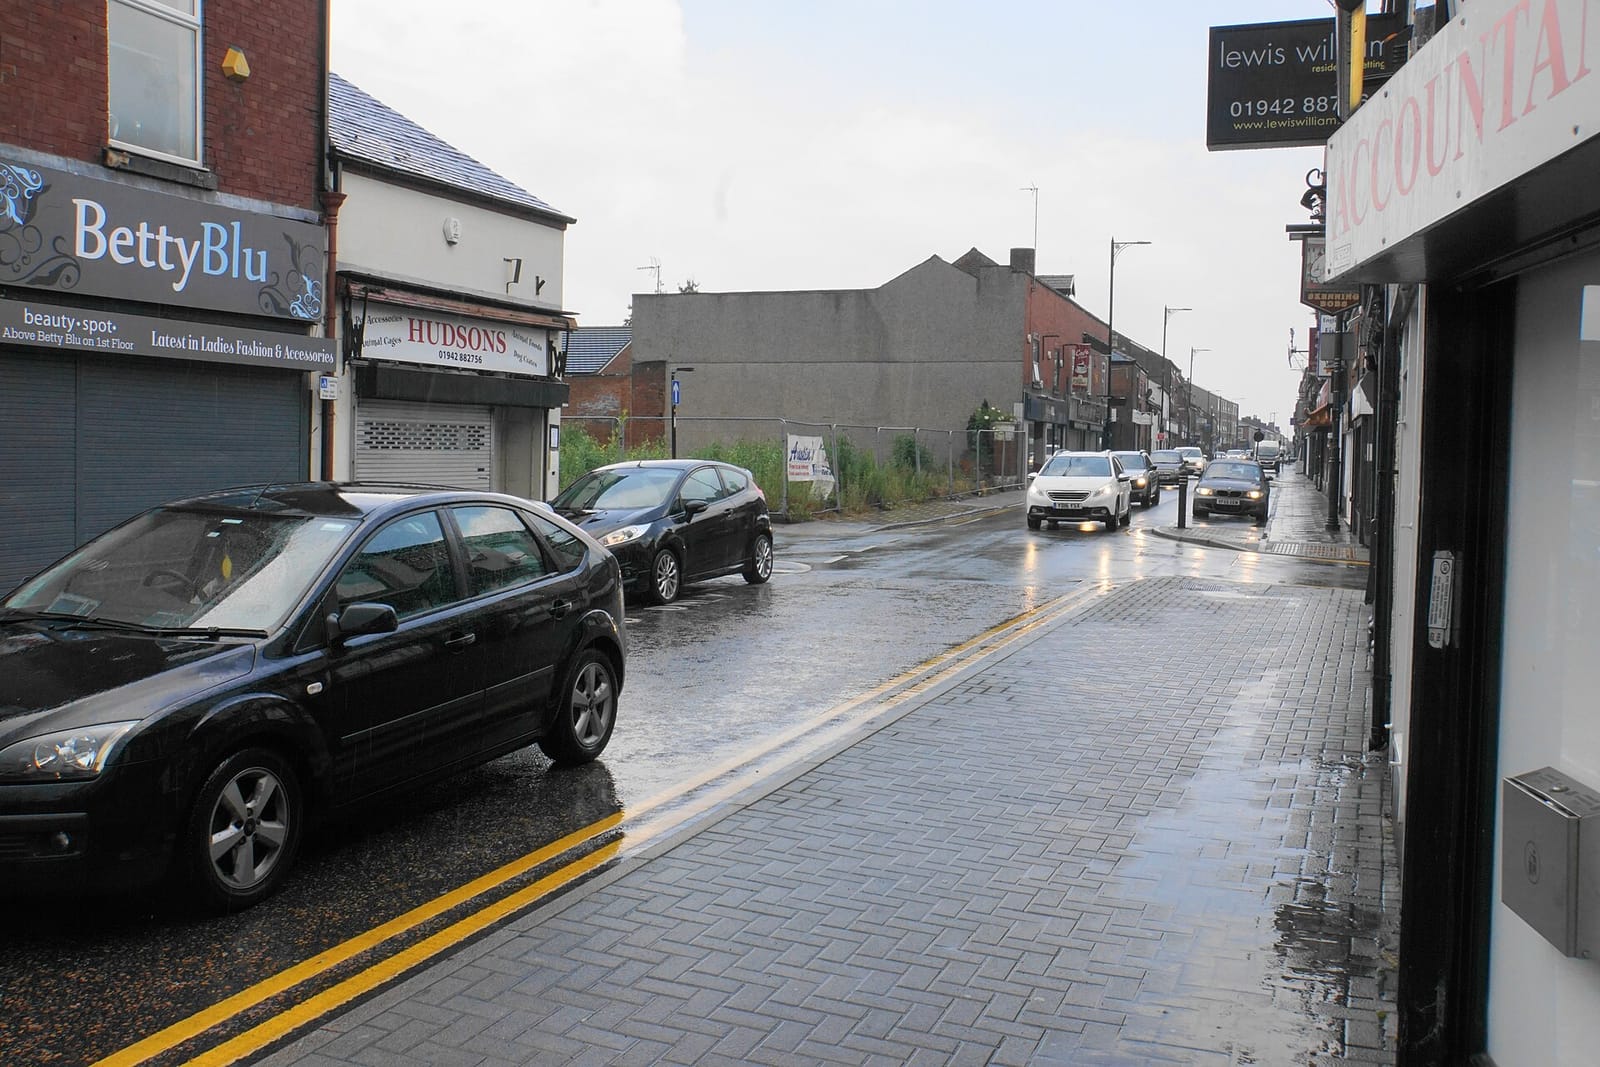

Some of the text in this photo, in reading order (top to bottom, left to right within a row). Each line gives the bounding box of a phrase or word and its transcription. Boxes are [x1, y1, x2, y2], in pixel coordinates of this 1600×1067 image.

[1220, 32, 1384, 68] lewis wilm
[1312, 63, 1338, 73] reside
[1230, 98, 1295, 117] 01942
[1331, 0, 1591, 241] ACCOUNTA
[1233, 117, 1340, 130] www.lewiswilliam
[2, 327, 134, 350] Above Betty Blu on 1st Floor
[151, 330, 334, 364] Latest in Ladies Fashion & Accessories
[407, 317, 507, 354] HUDSONS
